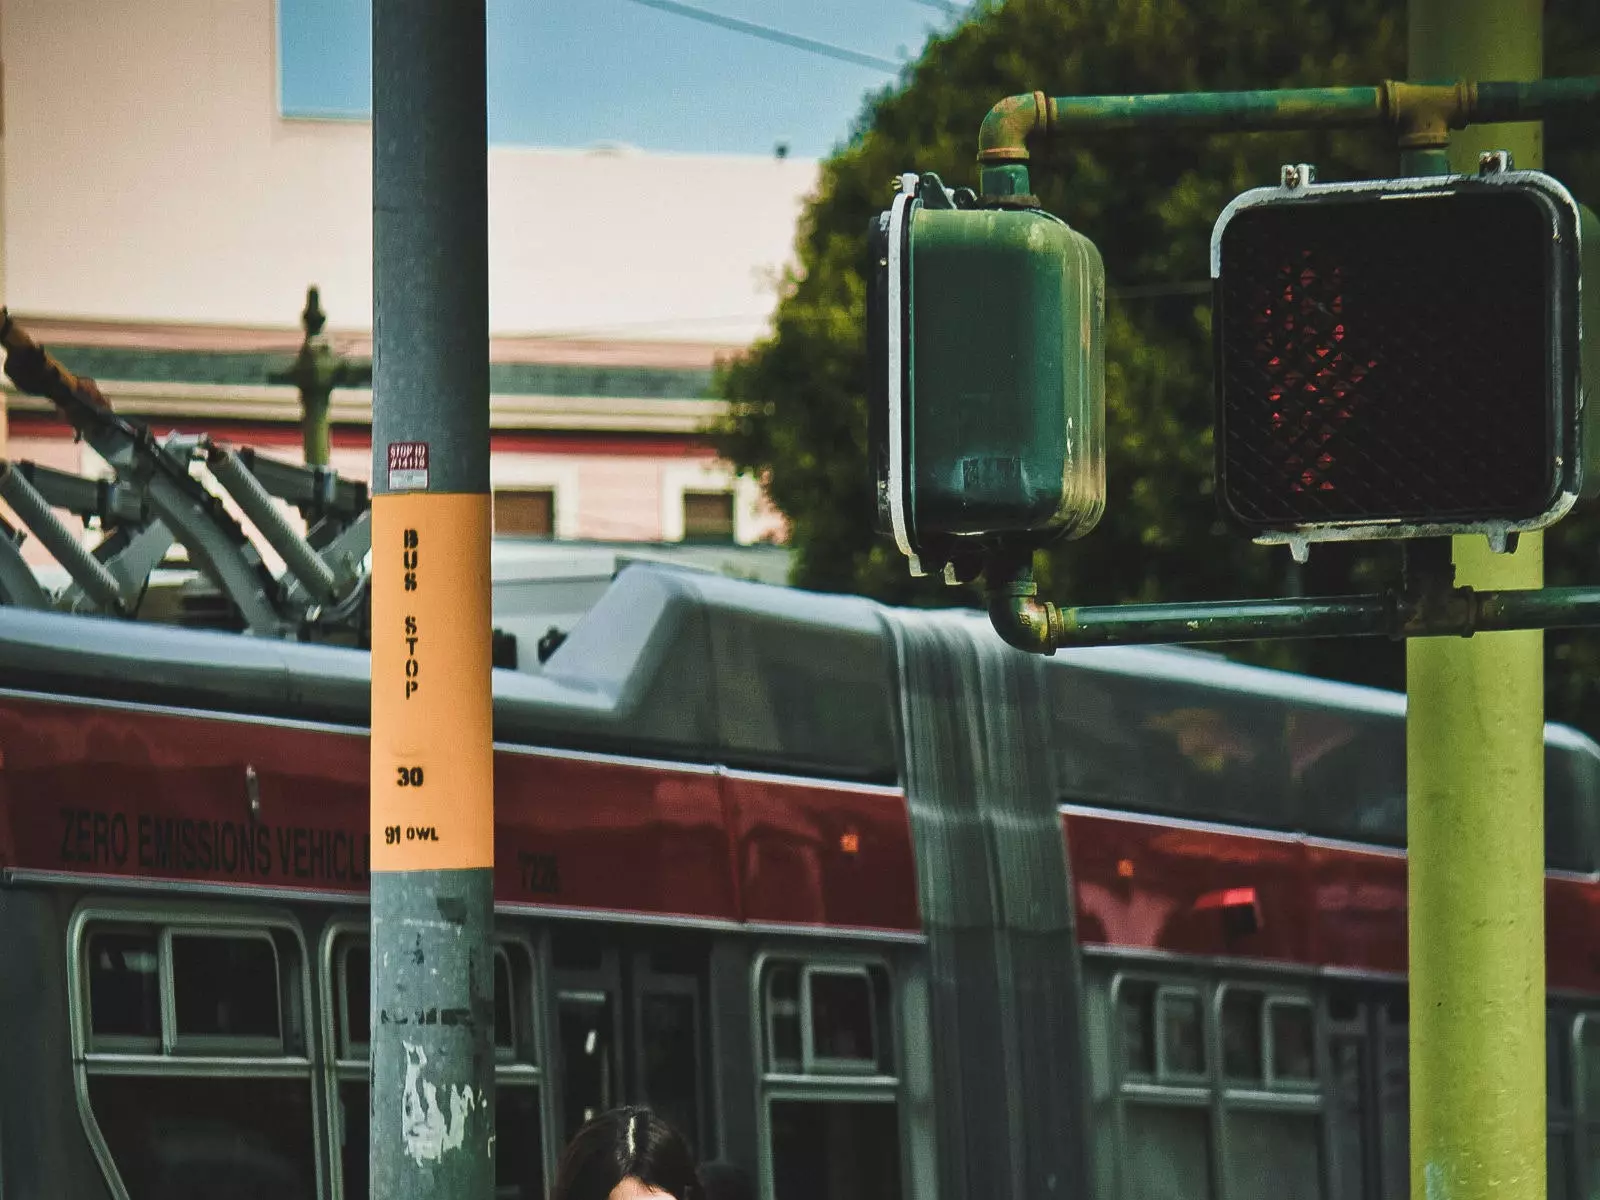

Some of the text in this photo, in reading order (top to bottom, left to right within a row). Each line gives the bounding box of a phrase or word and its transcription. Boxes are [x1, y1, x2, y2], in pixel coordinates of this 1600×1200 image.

[390, 444, 426, 458] STOP ID
[403, 529, 419, 701] BUS STOP
[396, 766, 425, 788] 30
[59, 807, 129, 867] ZERO
[137, 814, 272, 877] EMISSIONS
[384, 825, 440, 845] 91 OWL
